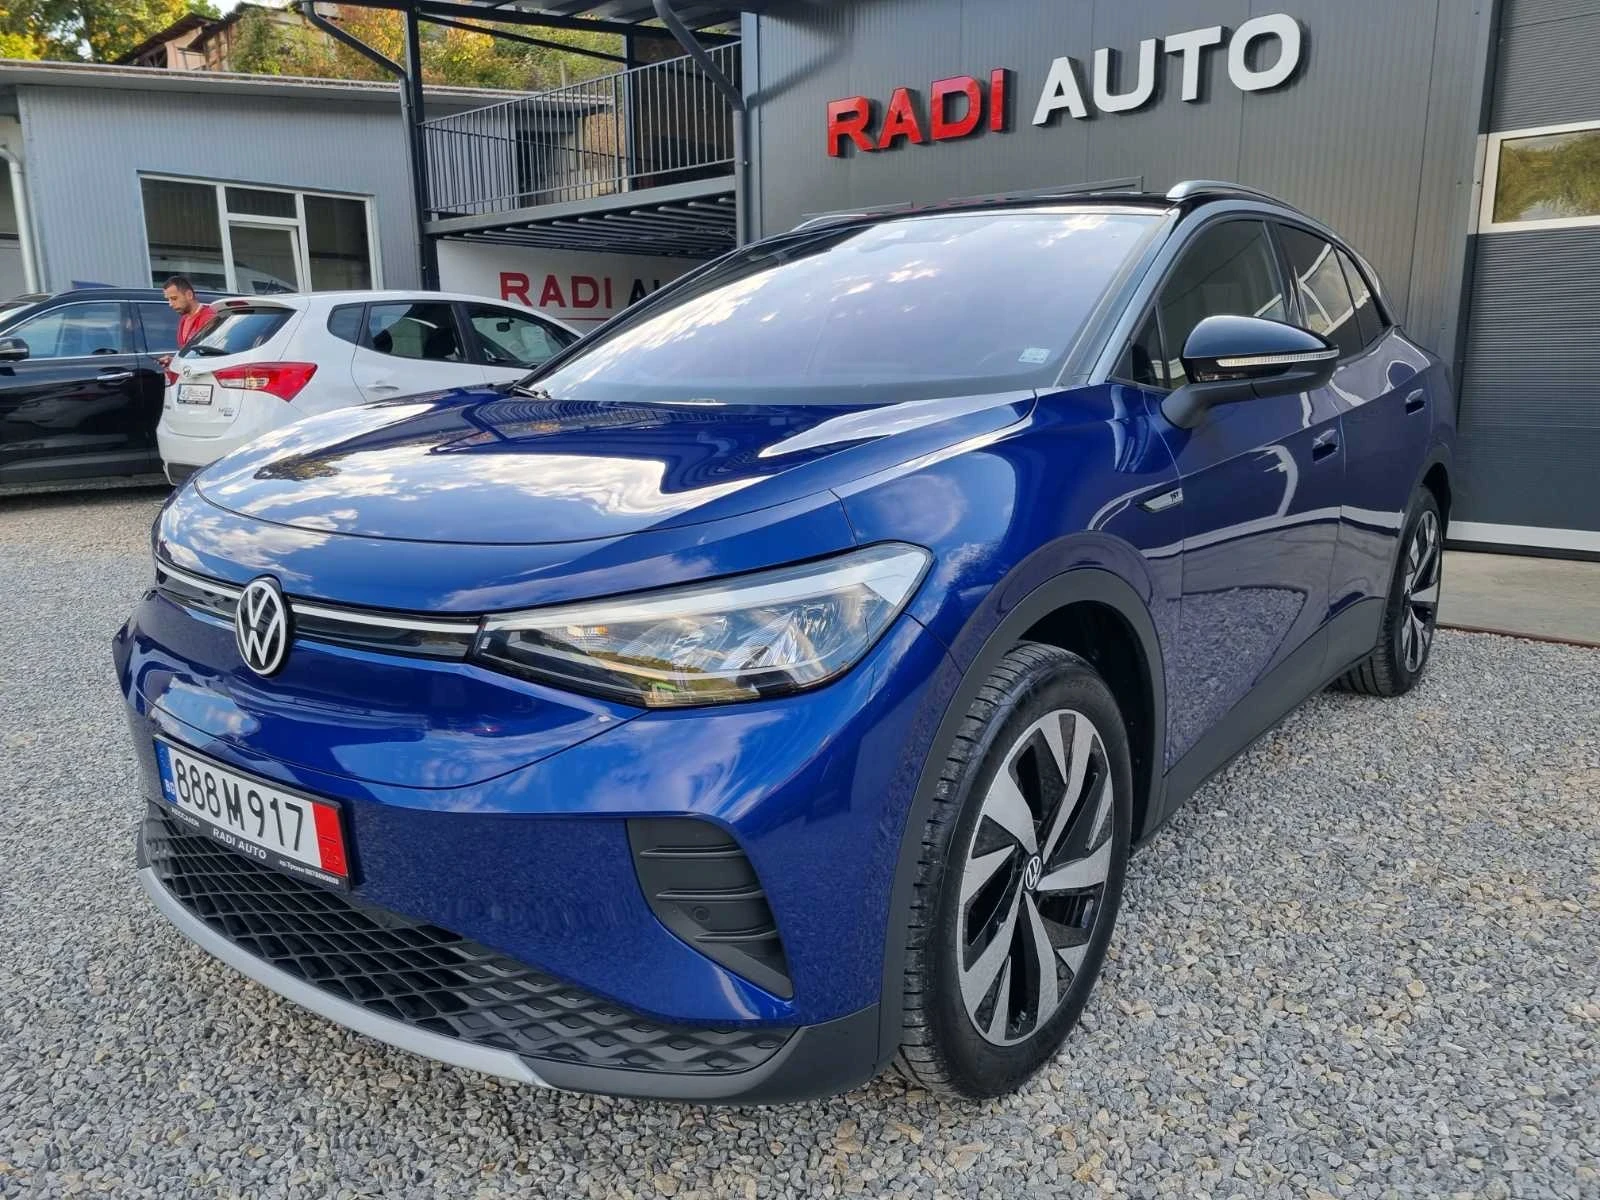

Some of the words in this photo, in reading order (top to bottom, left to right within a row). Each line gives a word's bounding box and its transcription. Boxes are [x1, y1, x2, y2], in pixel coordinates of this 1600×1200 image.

[827, 68, 1010, 157] RADI
[1032, 13, 1302, 126] AUTO
[500, 271, 612, 309] RADI
[175, 758, 303, 851] 888M917
[213, 827, 236, 847] RADI
[238, 840, 267, 860] AUTO
